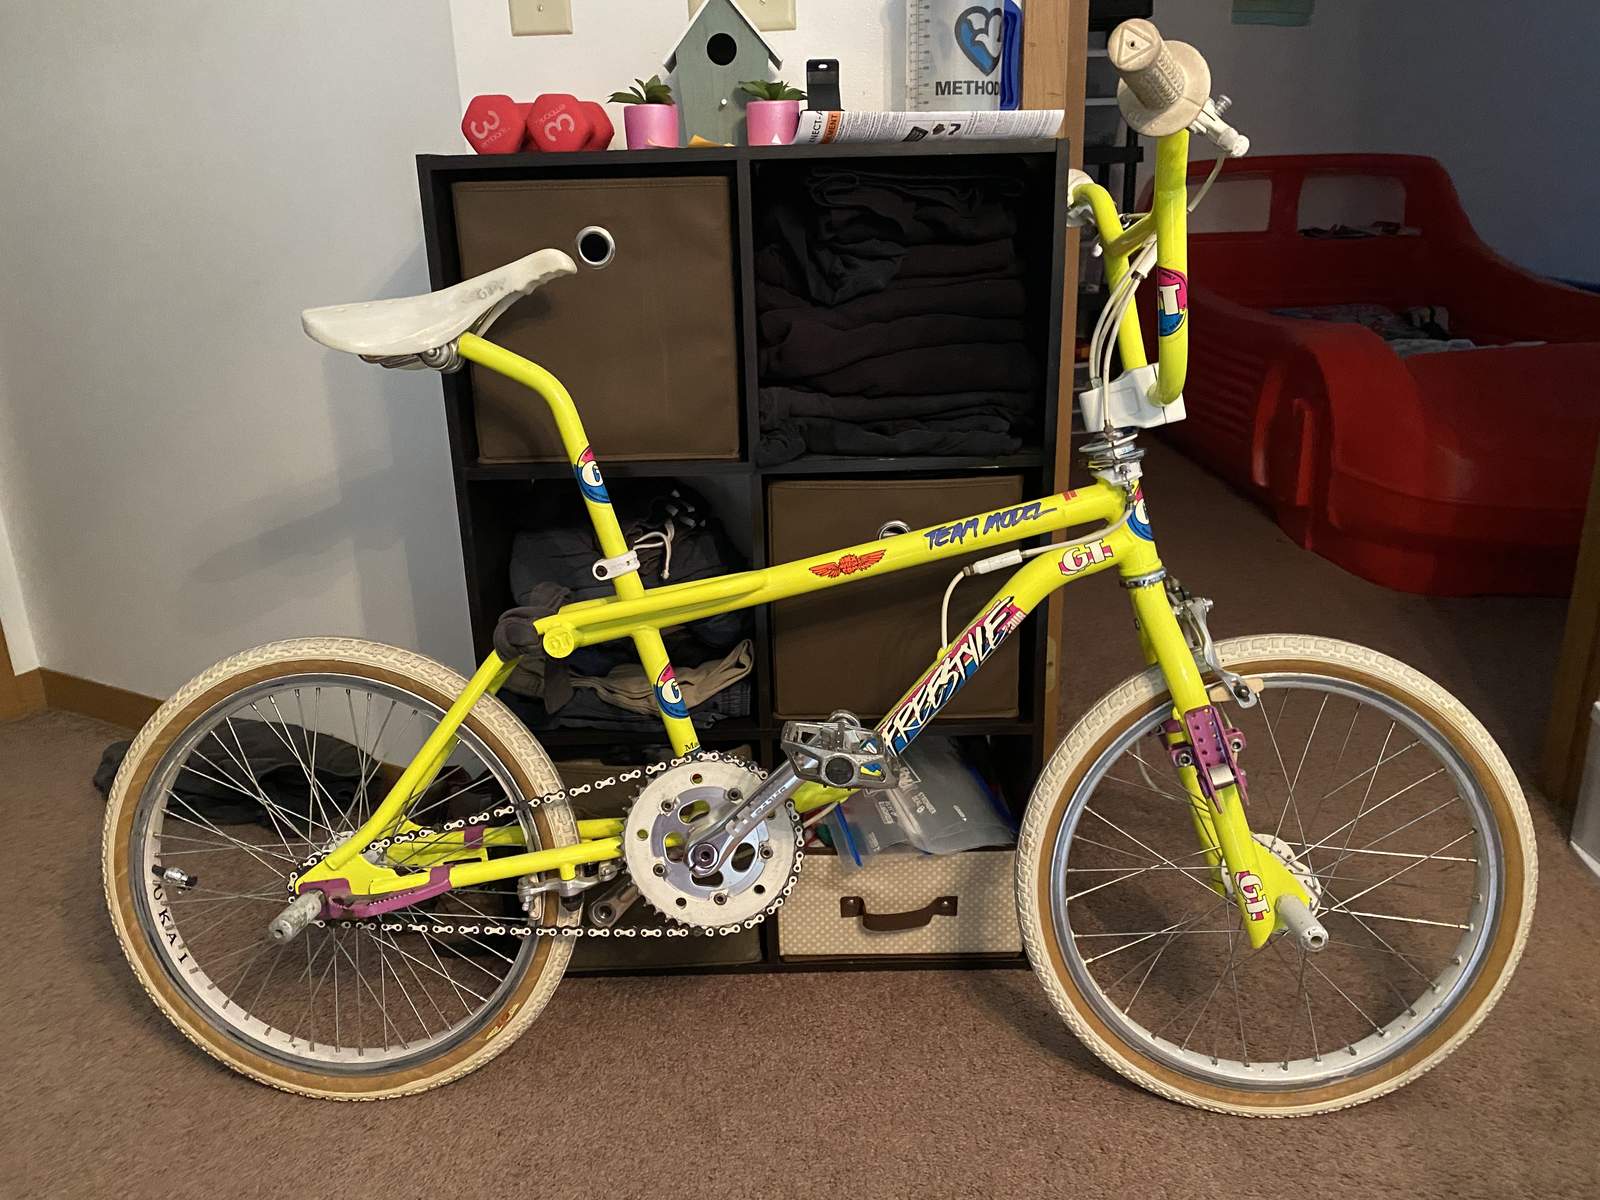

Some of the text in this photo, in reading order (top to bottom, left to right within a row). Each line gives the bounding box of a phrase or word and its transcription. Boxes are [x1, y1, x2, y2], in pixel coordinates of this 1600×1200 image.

[470, 110, 500, 139] 3
[544, 113, 575, 142] 3
[924, 502, 1057, 550] TEAM MODEL
[1061, 538, 1106, 571] GT
[881, 596, 1014, 757] FREESTYLE
[1237, 872, 1271, 917] GT
